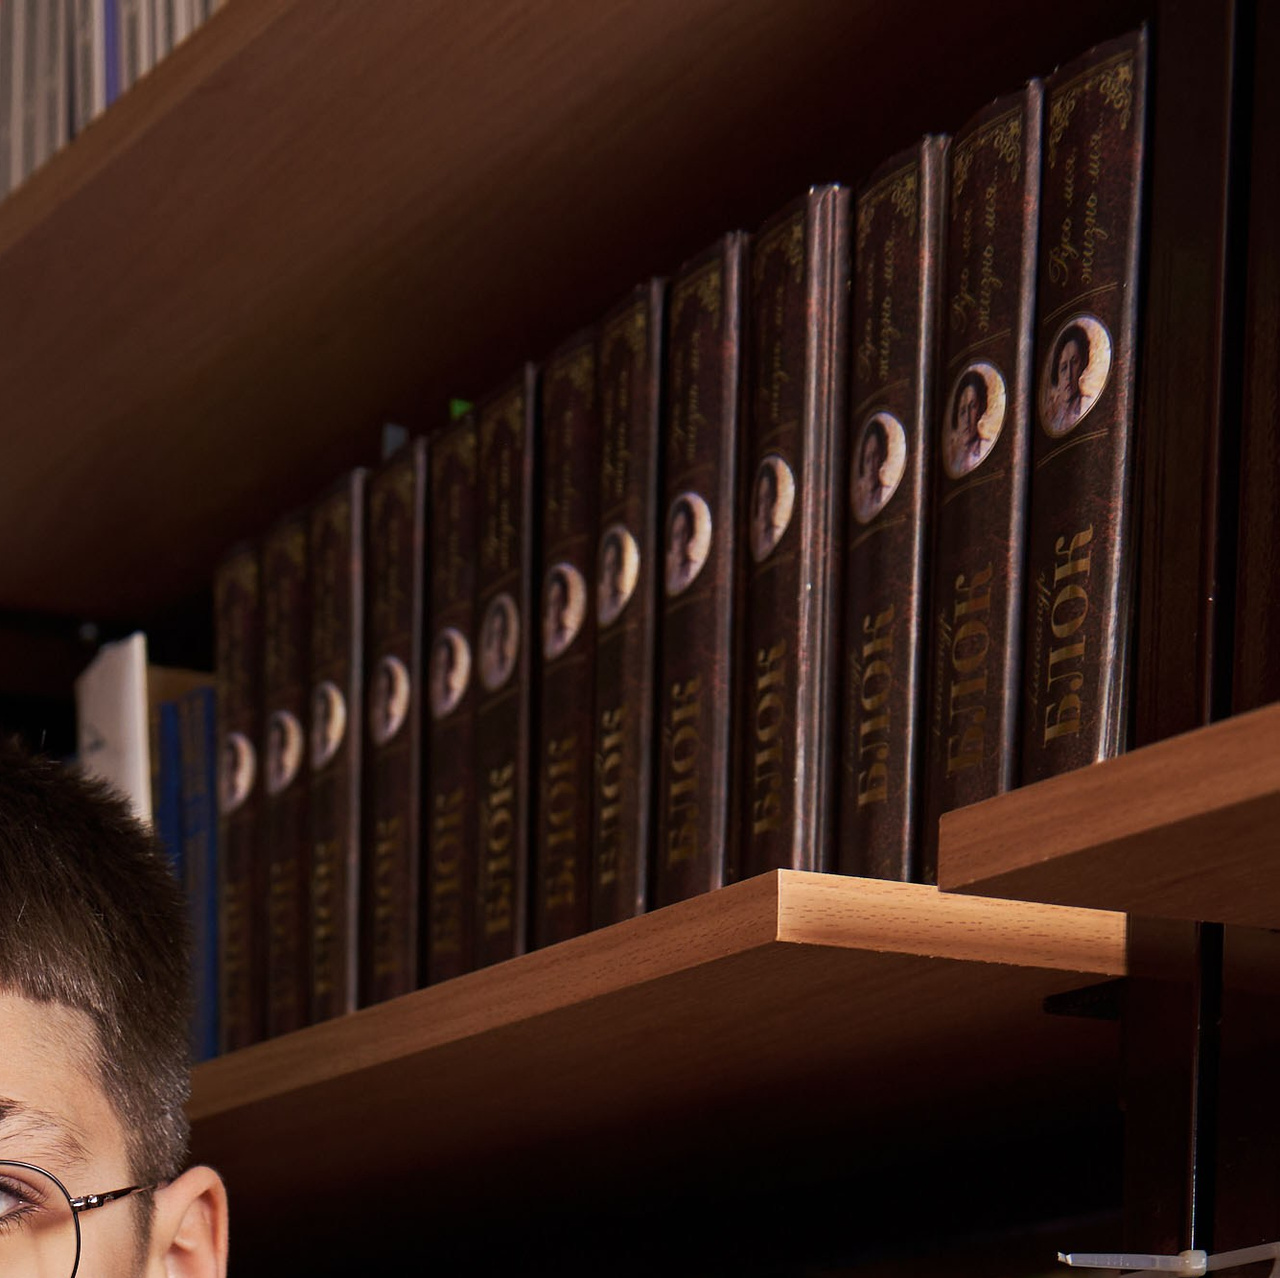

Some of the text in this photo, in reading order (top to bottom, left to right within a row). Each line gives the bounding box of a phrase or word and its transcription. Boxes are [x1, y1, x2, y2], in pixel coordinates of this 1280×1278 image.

[1081, 193, 1109, 283] жизнь
[753, 638, 787, 836] БЛОК
[858, 603, 895, 813] БЛОК
[945, 561, 993, 779] БЛОК
[1043, 523, 1094, 748] БЛОК
[669, 675, 702, 868] БЛОК
